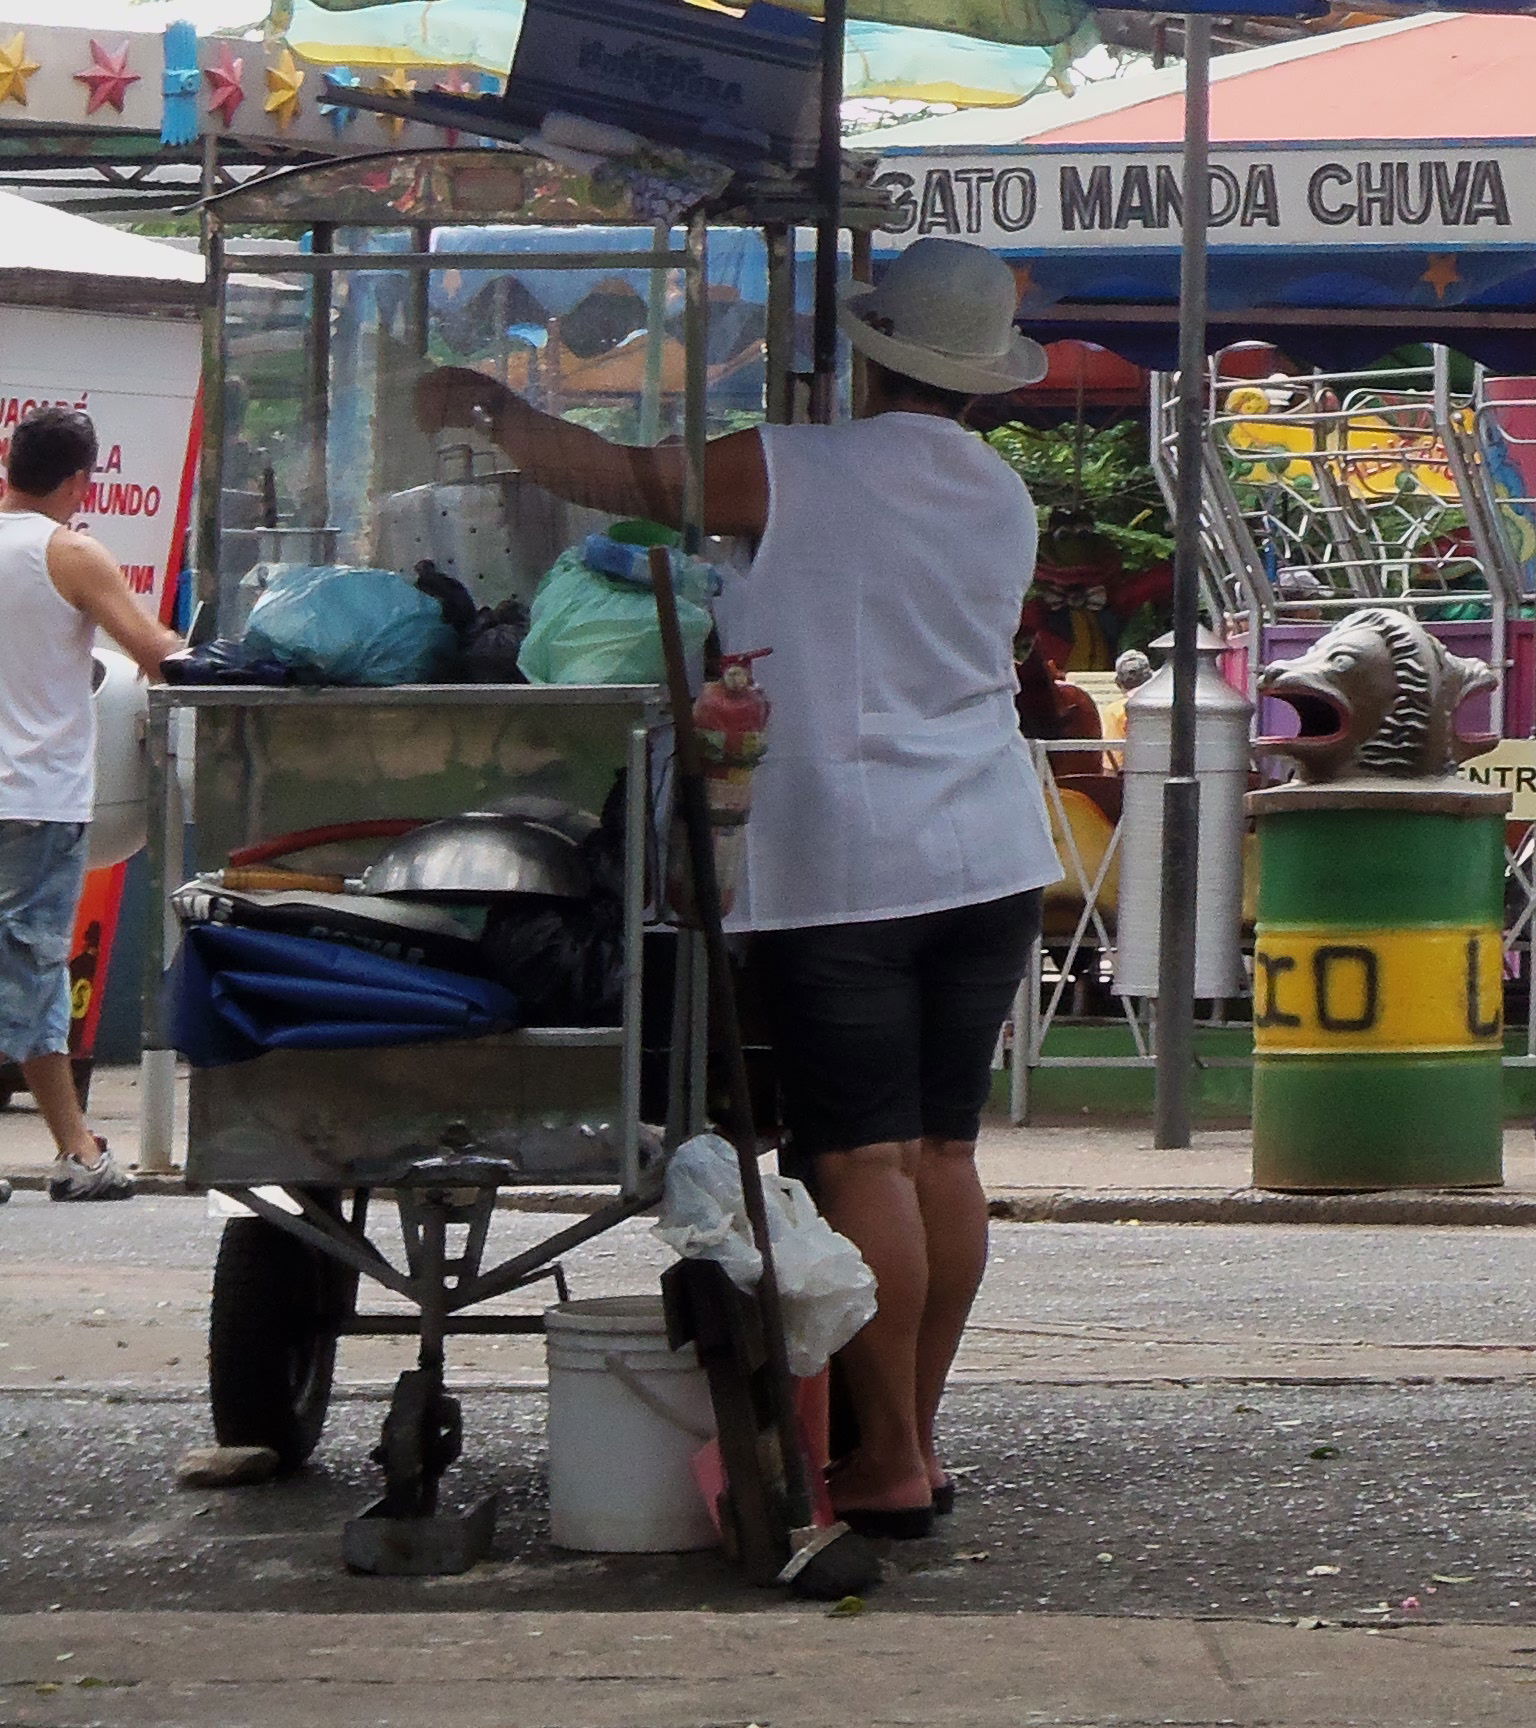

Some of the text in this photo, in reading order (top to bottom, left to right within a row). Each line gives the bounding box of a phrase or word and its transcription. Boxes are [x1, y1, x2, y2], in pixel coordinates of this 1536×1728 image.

[871, 159, 1512, 234] GATO MANDA CHUVA
